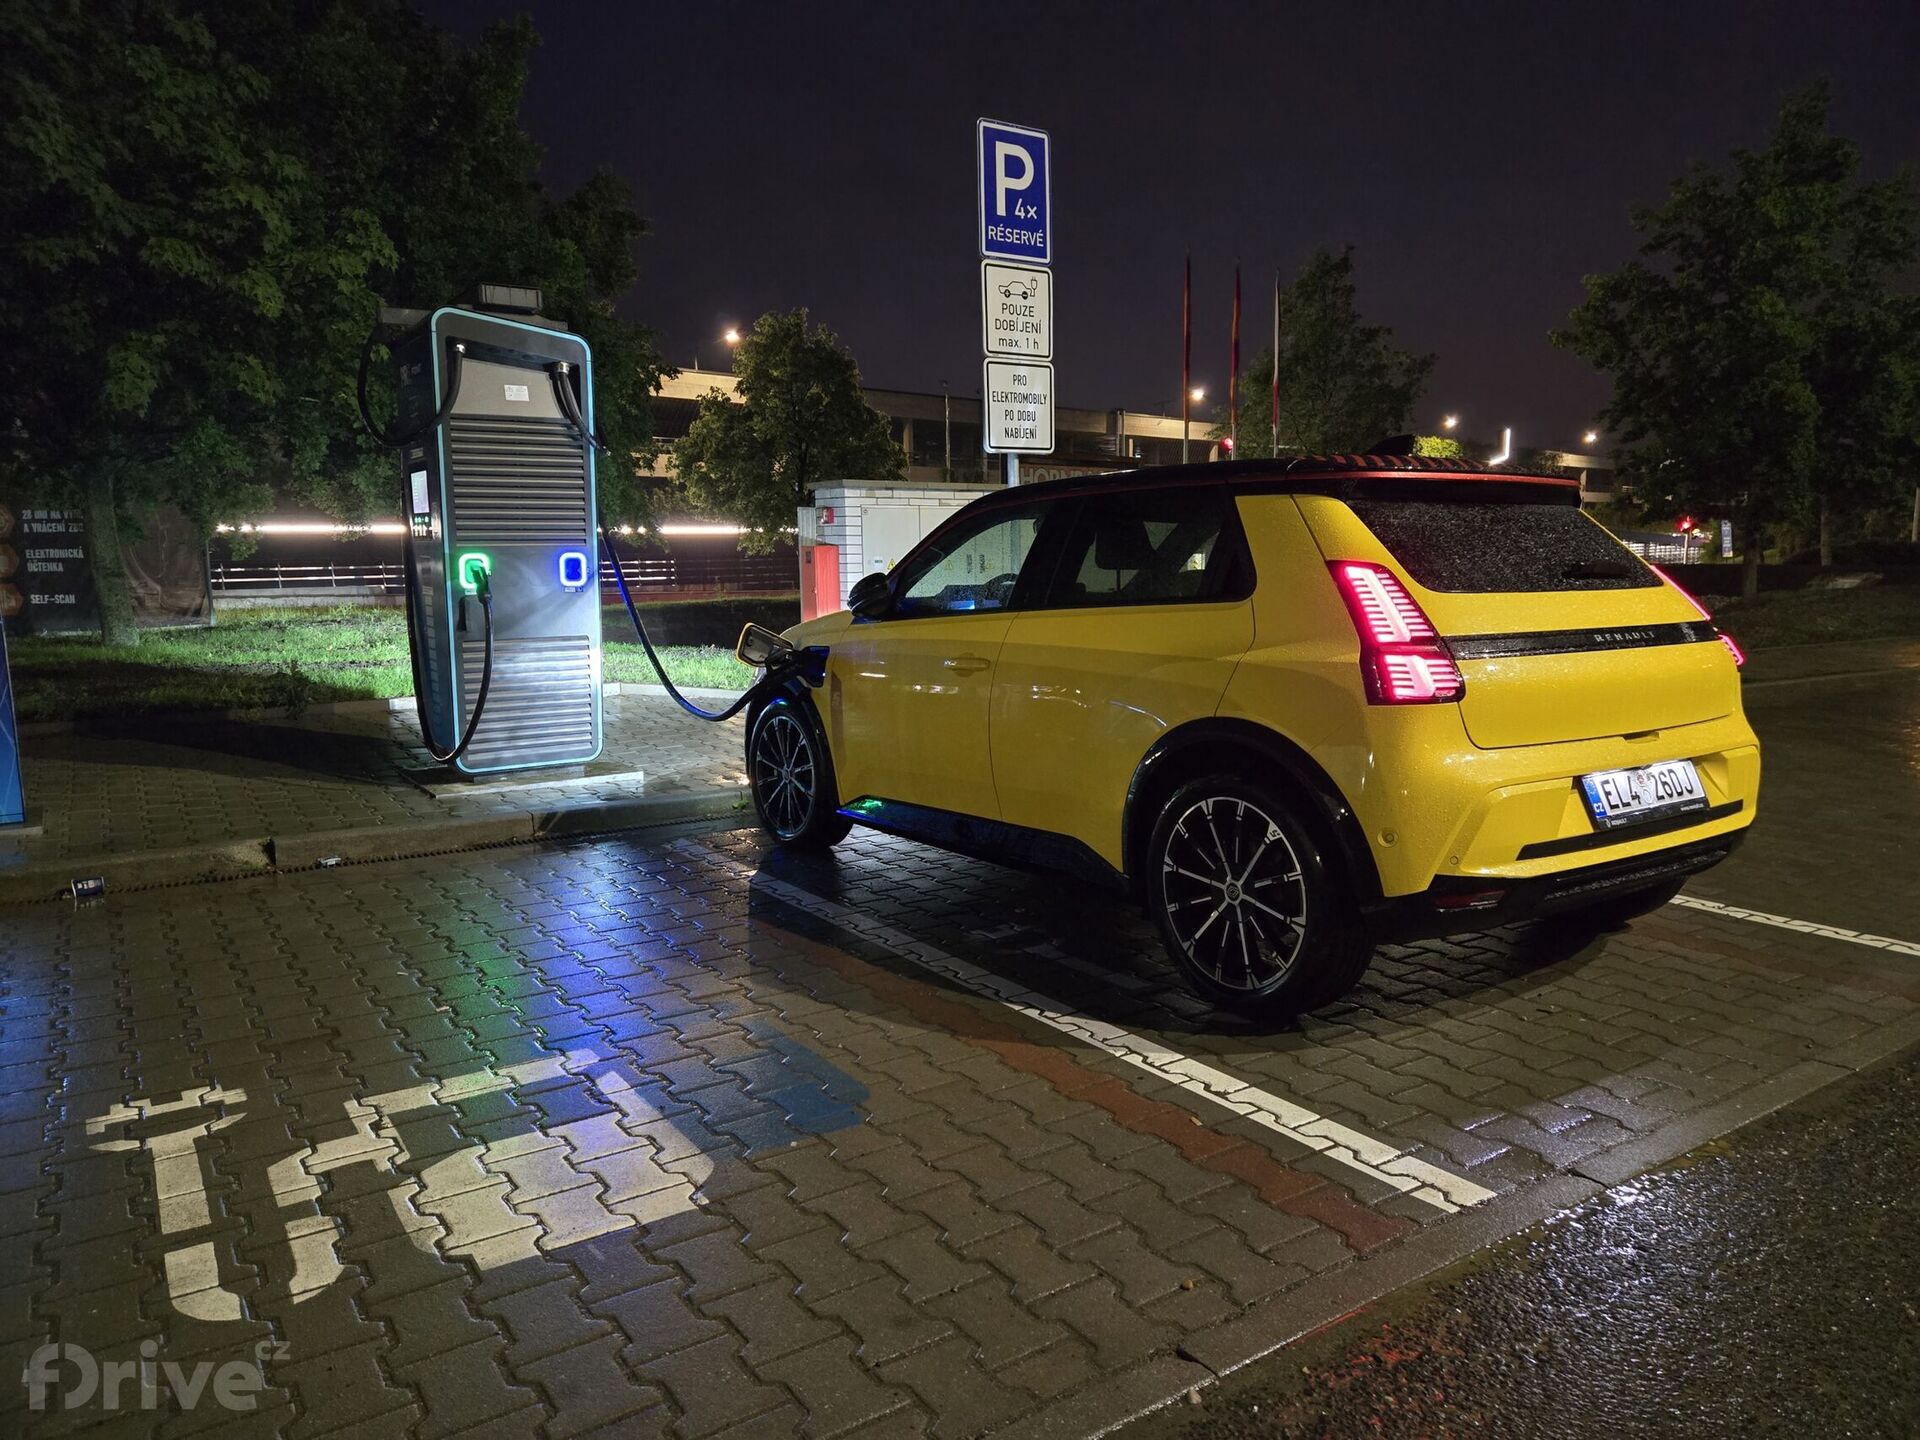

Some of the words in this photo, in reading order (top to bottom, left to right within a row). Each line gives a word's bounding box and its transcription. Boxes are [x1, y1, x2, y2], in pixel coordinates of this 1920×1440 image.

[995, 140, 1035, 217] P
[1014, 198, 1038, 220] 4x
[988, 223, 1044, 247] RÉSERVÉ
[1001, 302, 1035, 318] POUZE
[994, 317, 1042, 334] DOBÍJENÍ
[998, 337, 1022, 348] max.
[1026, 337, 1030, 349] 1
[1033, 338, 1039, 350] h
[1012, 374, 1027, 386] PRO
[992, 390, 1047, 405] ELEKTROMOBILY
[1004, 409, 1014, 421] PO
[1017, 410, 1036, 422] DOBU
[1004, 424, 1037, 439] NABÍJENÍ
[23, 522, 30, 533] A
[24, 546, 84, 559] ELEKTRONICKÁ
[30, 593, 76, 604] SELF-SCAN
[1594, 631, 1655, 642] RENAULT
[1593, 802, 1605, 813] CZ
